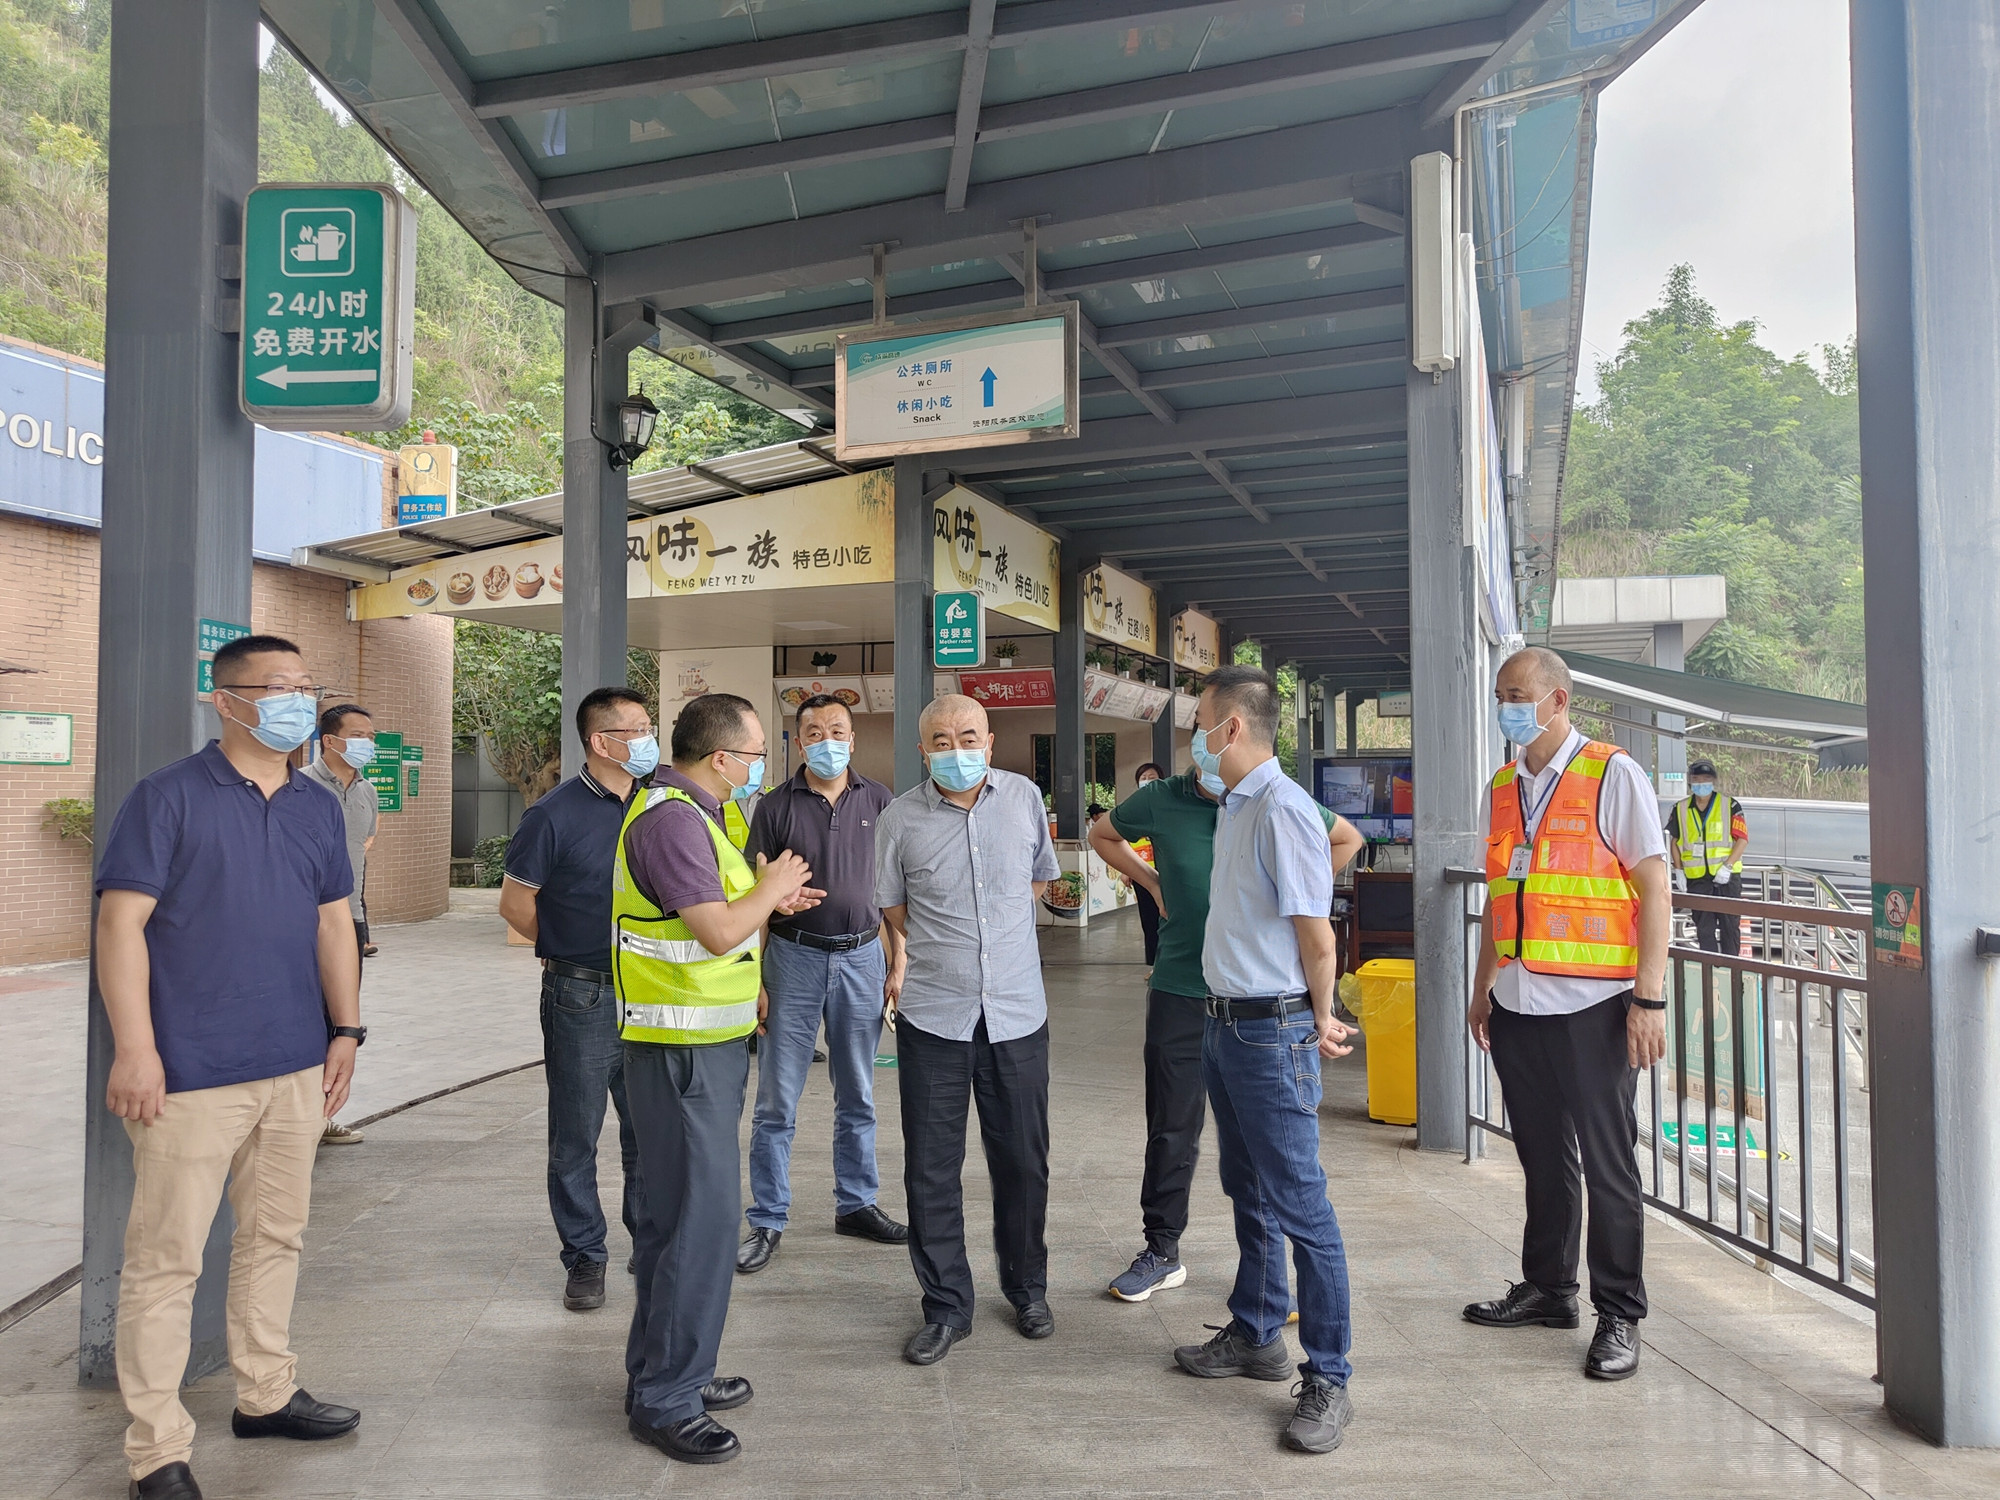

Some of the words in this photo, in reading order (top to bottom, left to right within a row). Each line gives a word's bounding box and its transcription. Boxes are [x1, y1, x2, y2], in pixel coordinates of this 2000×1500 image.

[267, 289, 369, 319] 24小时
[253, 327, 381, 357] 免费开水
[896, 359, 953, 378] 公共厕所
[896, 395, 953, 414] 休闲小吃
[912, 413, 942, 424] Snack
[0, 408, 104, 466] OLIC
[402, 503, 443, 513] 警务工作站
[626, 516, 780, 570] 风味一族
[792, 545, 873, 571] 特色小吃
[934, 505, 1009, 585] 风味一族
[1014, 571, 1050, 608] 特色小吃
[667, 578, 696, 590] FENG
[699, 576, 722, 589] WEI
[724, 575, 738, 587] YI
[741, 573, 757, 586] ZU
[958, 569, 973, 585] FENG
[939, 627, 972, 639] 母婴室
[1546, 912, 1607, 941] 管理
